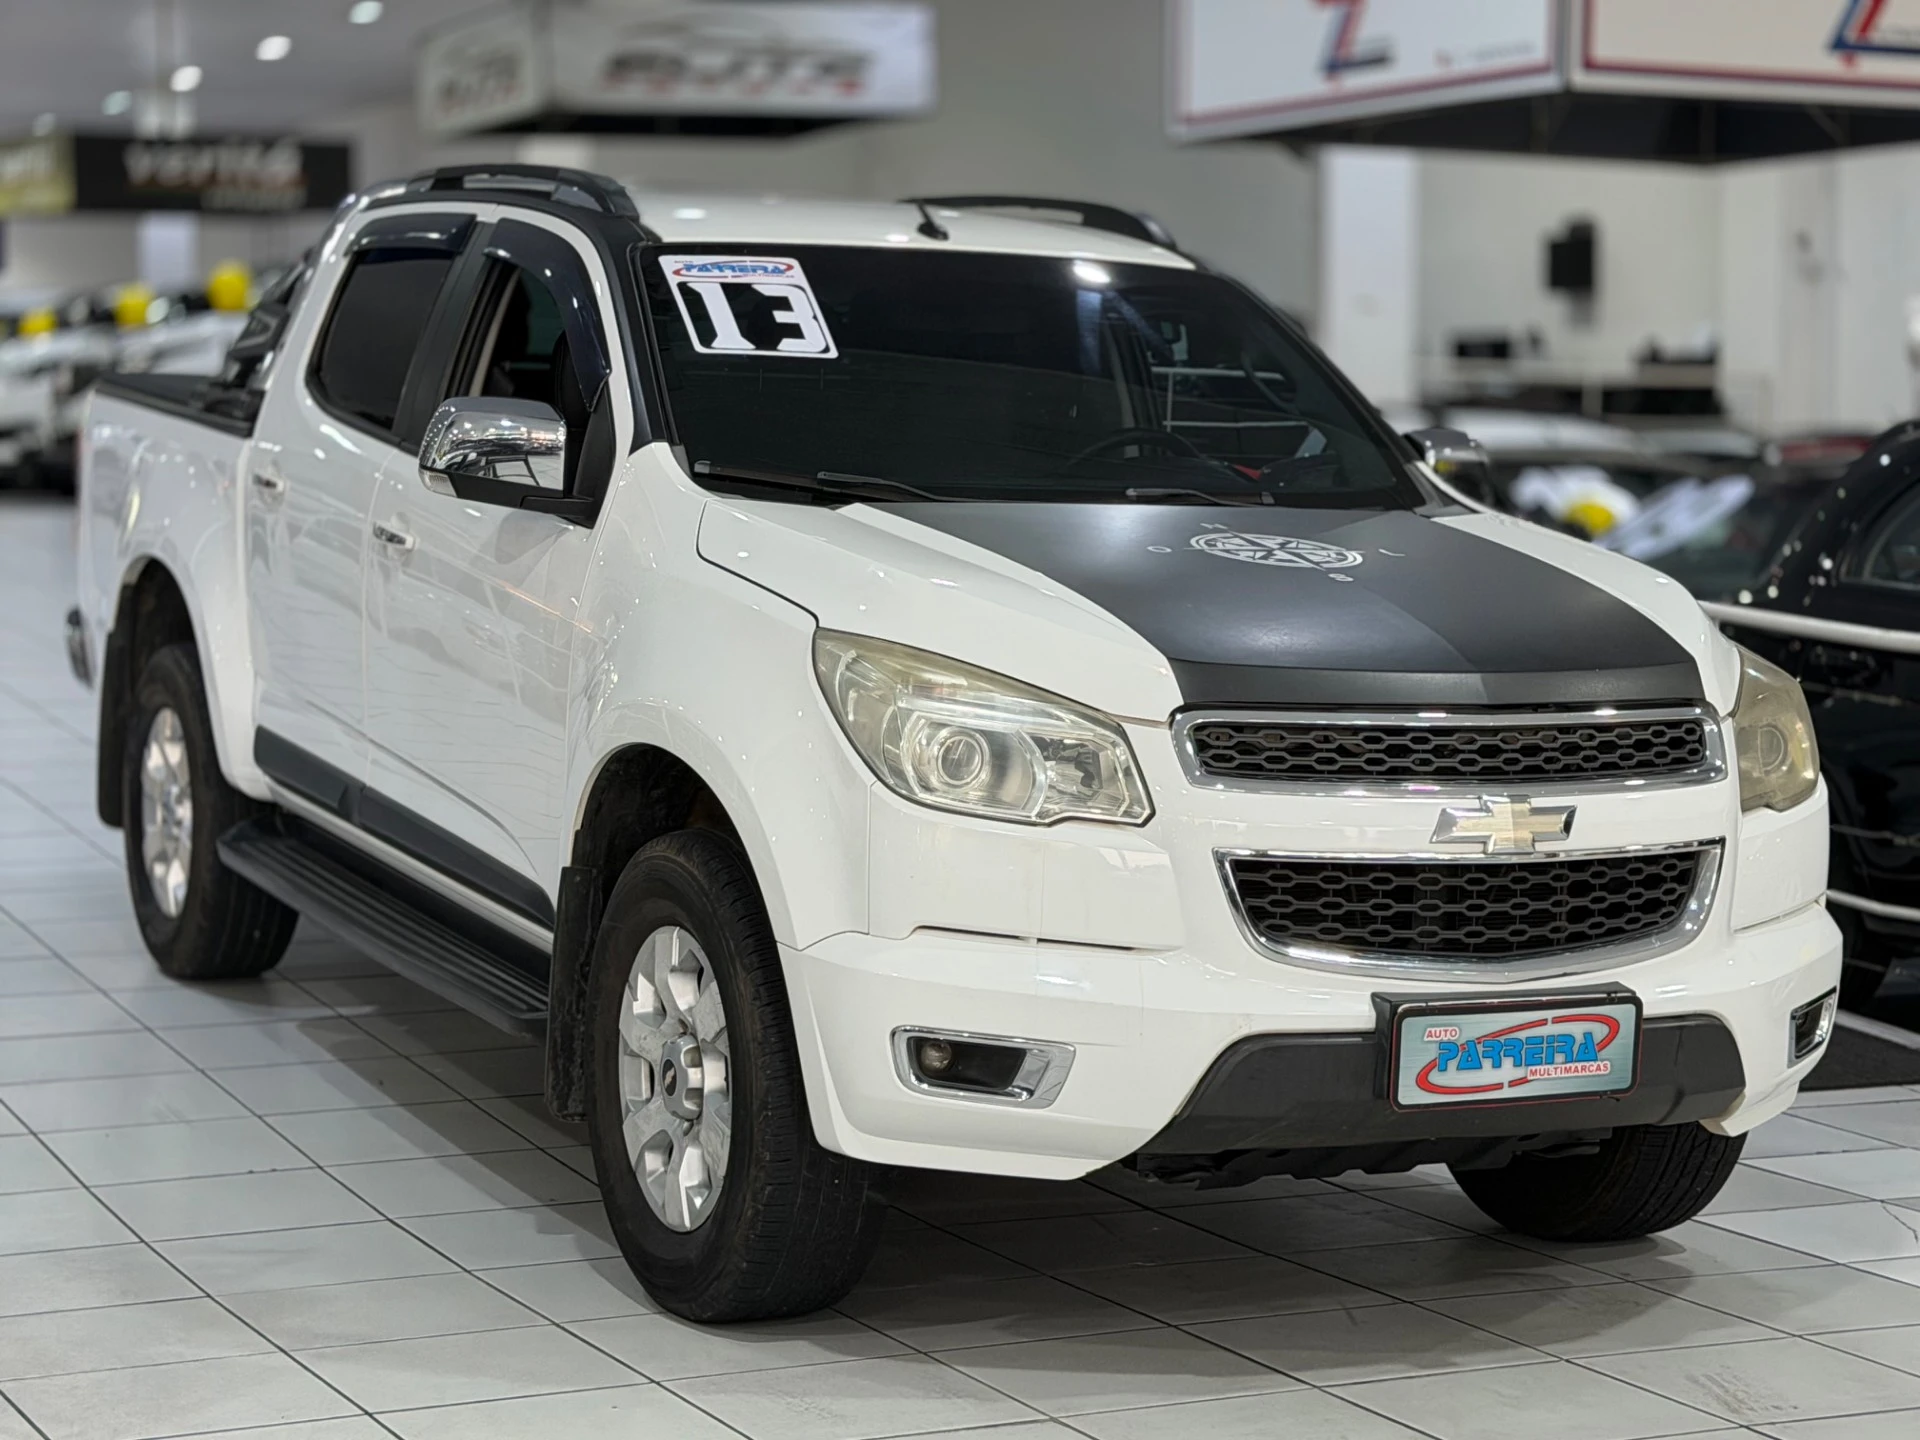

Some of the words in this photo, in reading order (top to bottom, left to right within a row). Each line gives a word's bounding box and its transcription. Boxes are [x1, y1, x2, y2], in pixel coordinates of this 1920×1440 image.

[686, 282, 827, 353] 13
[1426, 1028, 1458, 1038] AUTO
[1438, 1031, 1598, 1072] PARREIRA
[1529, 1062, 1609, 1077] MULTIMARCAS
